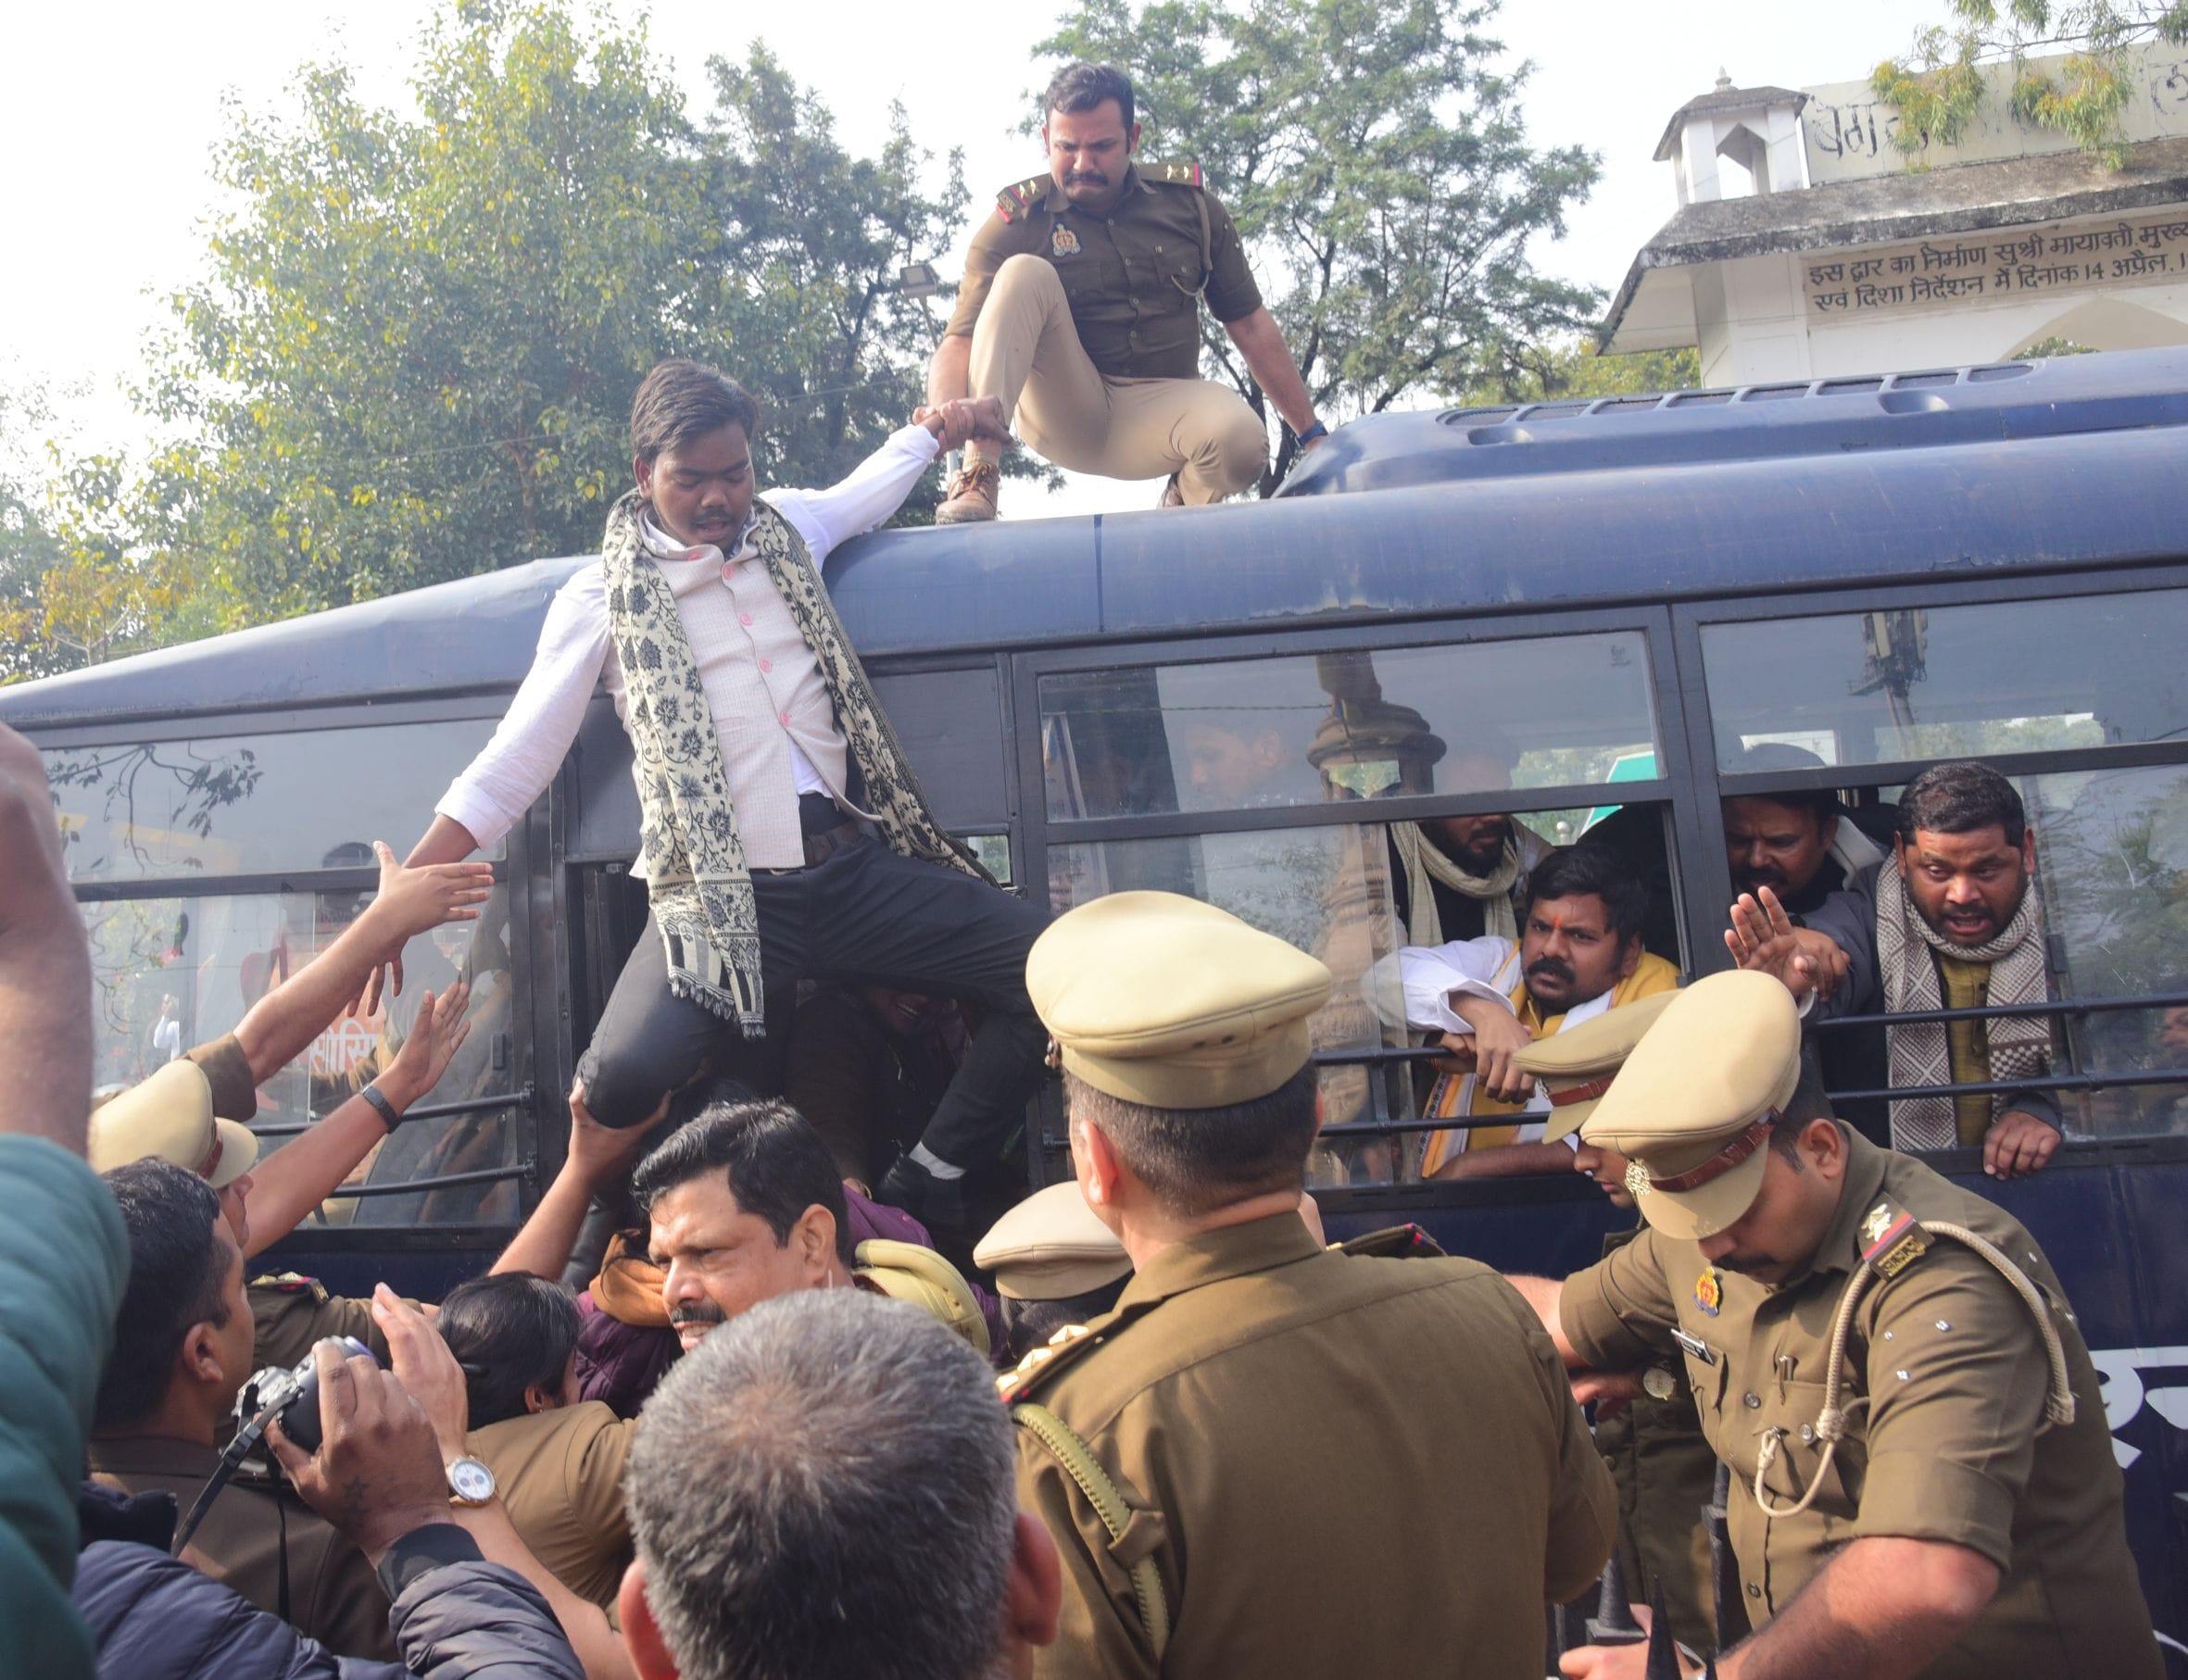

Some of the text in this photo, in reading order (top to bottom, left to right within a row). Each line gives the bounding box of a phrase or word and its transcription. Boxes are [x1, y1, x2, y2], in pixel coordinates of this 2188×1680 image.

[1809, 263, 1845, 286] इस
[1850, 258, 1884, 282] द्वार
[1890, 255, 1916, 273] का
[1920, 242, 1987, 271] निर्माण
[1993, 232, 2044, 265] सुश्री
[1813, 288, 1849, 311] एवं
[1855, 284, 1905, 307] दिशा
[1910, 274, 1985, 303] निर्देशन
[1994, 267, 2010, 290] में
[2017, 263, 2079, 289] दिनांक
[2085, 261, 2104, 281] 14
